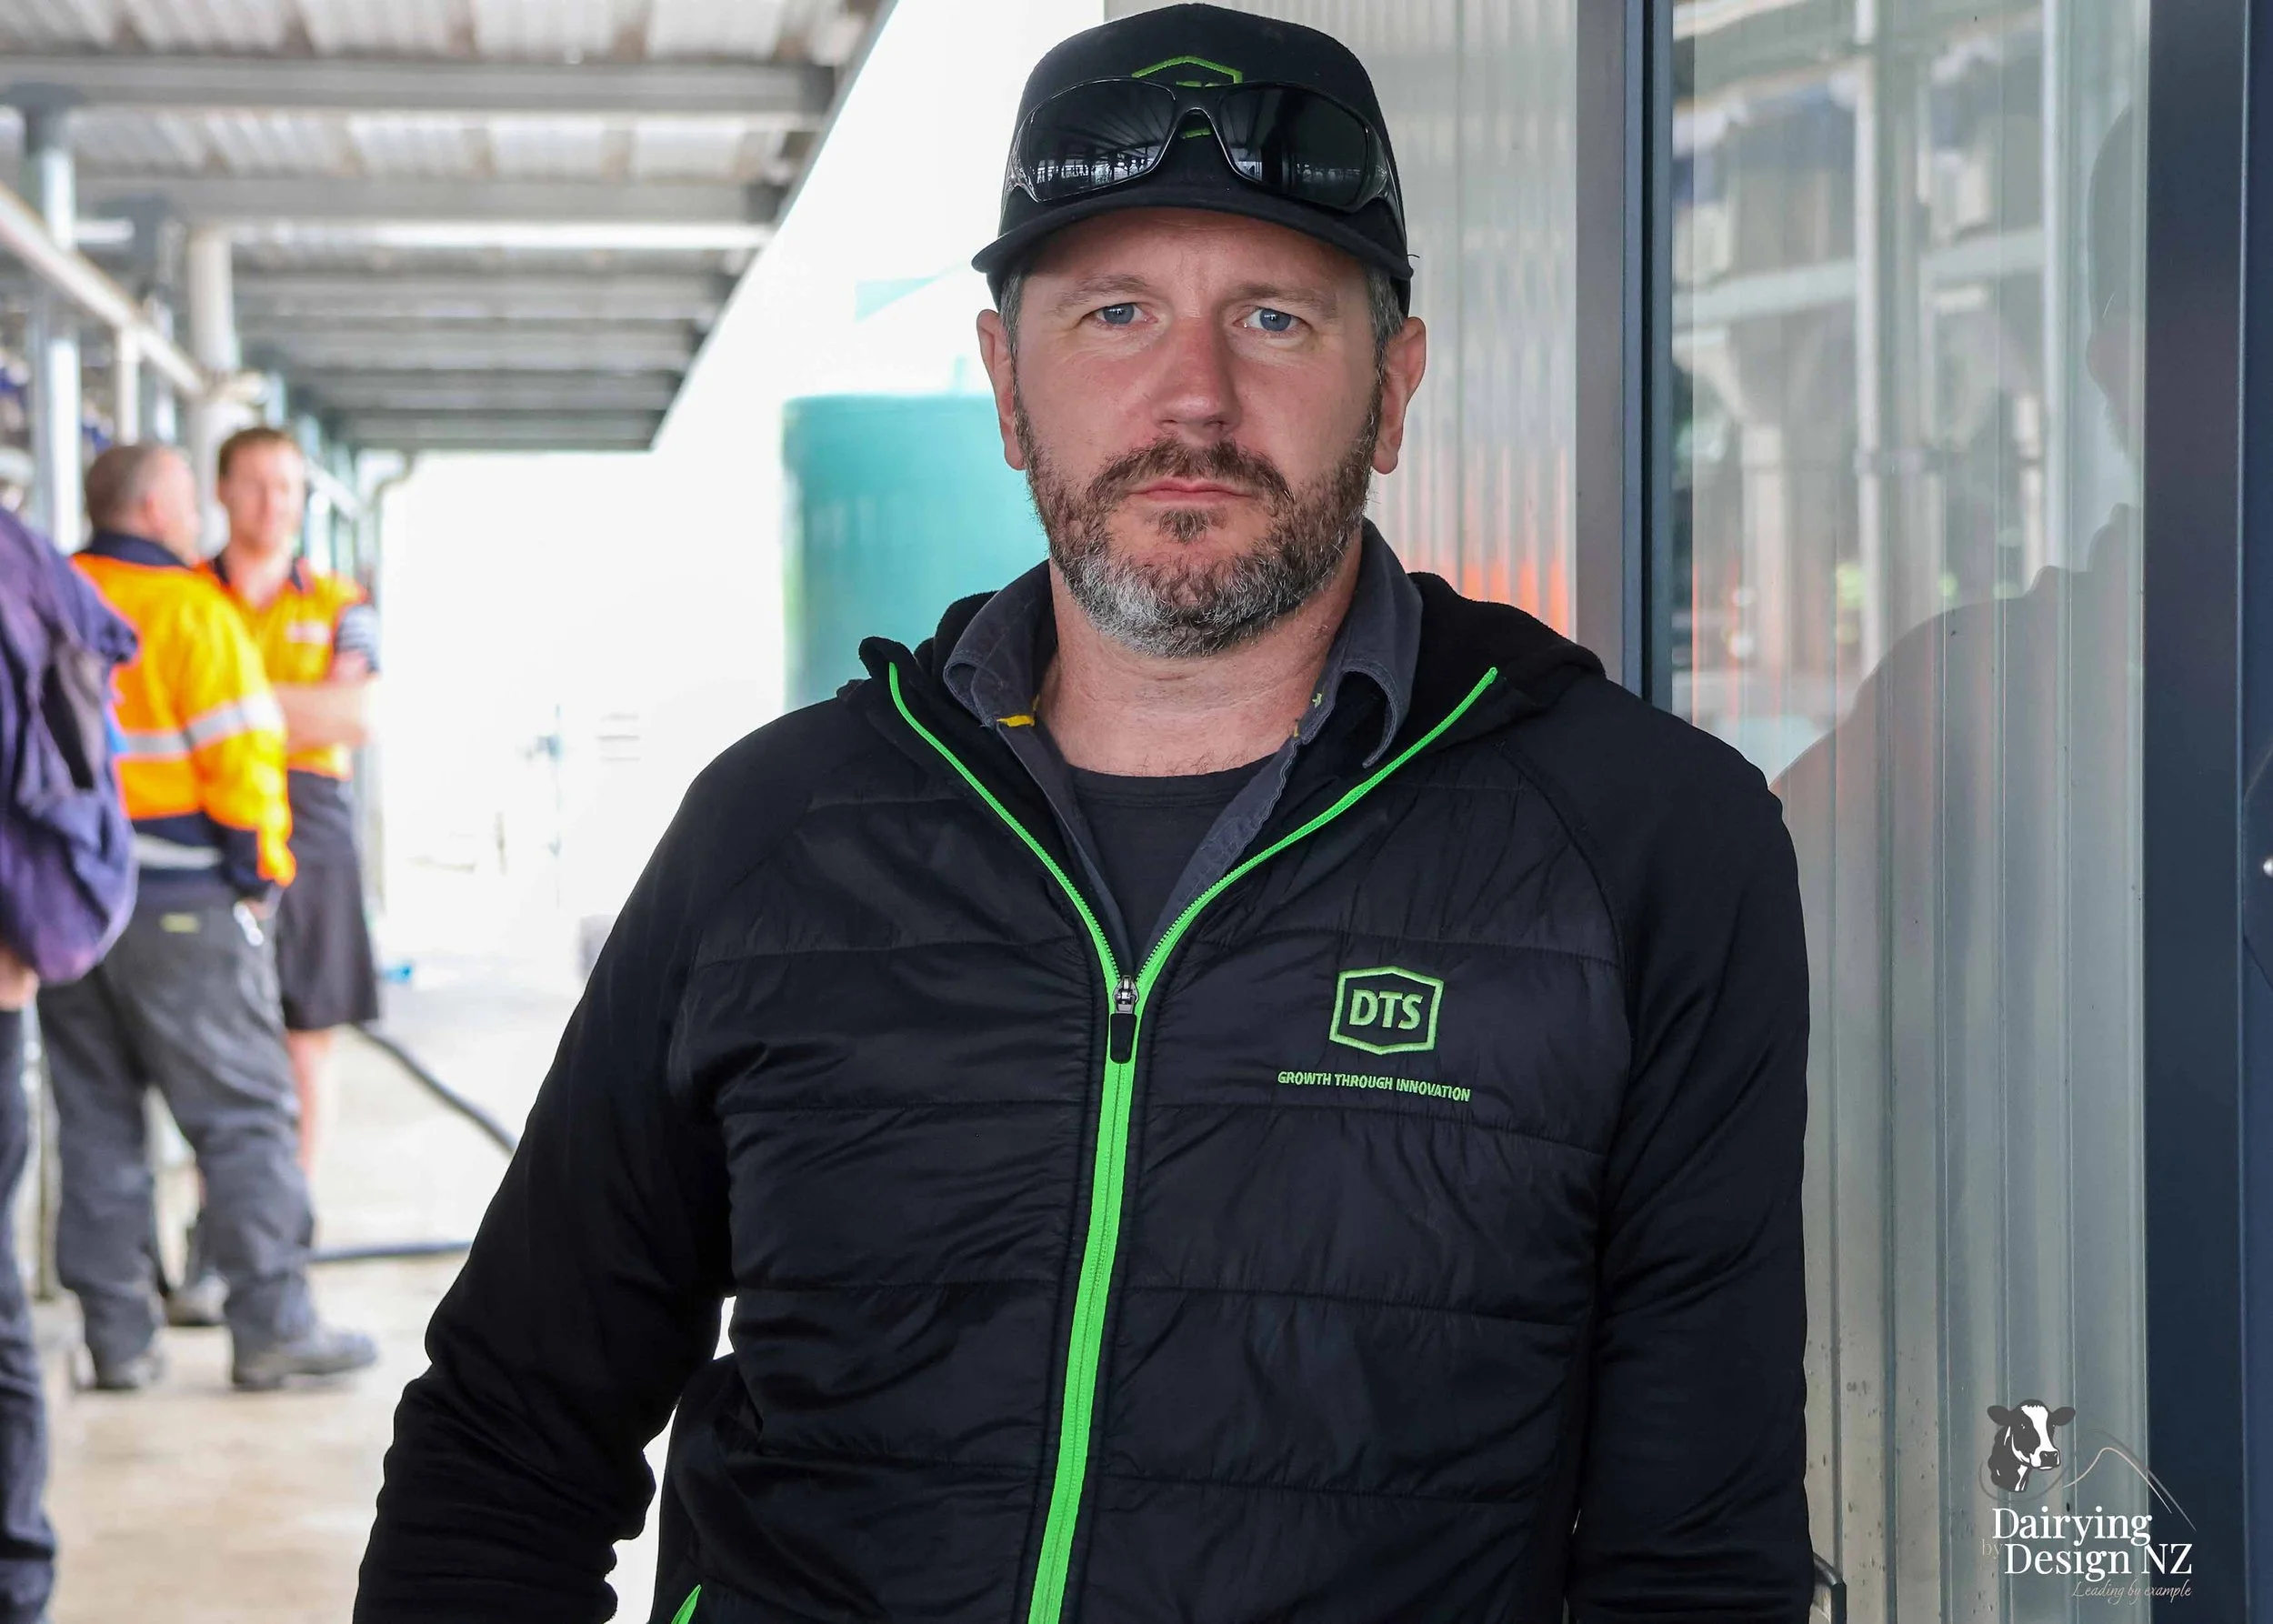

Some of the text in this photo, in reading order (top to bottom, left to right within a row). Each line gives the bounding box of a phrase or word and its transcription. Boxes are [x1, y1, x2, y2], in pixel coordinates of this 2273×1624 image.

[1349, 989, 1423, 1029] DTS
[1277, 1071, 1471, 1102] GROWTH THROUGH INNOVATION
